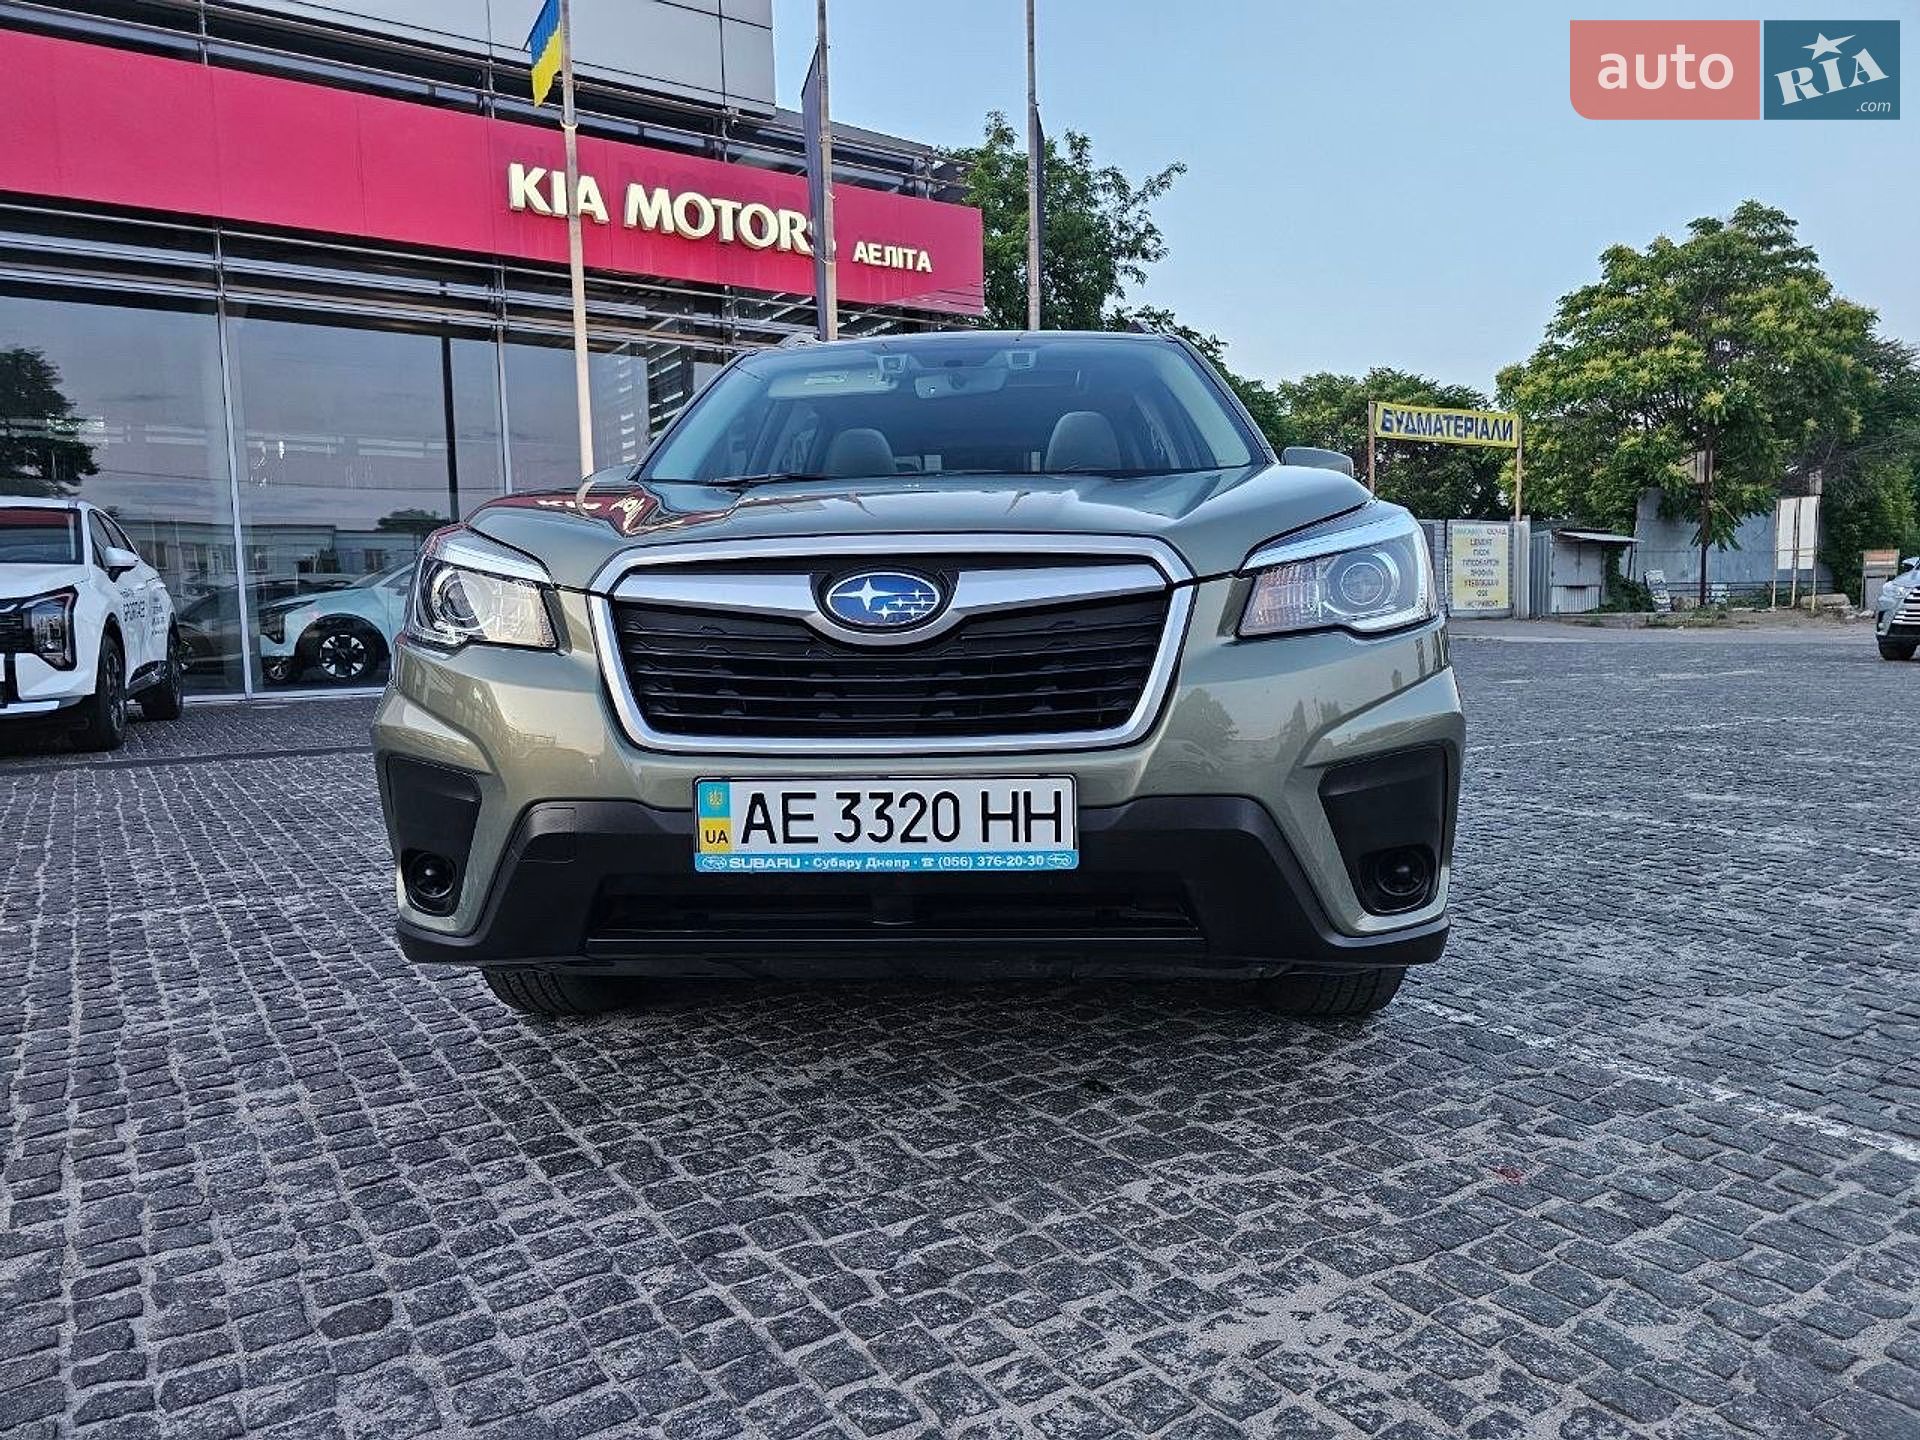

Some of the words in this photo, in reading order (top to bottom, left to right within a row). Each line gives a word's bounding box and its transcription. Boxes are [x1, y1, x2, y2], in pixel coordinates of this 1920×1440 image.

[508, 163, 610, 224] KIA
[623, 181, 837, 257] MOTOR
[852, 241, 933, 273] АЕЛІТА
[1380, 408, 1514, 442] БУДМАТЕРІАЛИ
[741, 791, 819, 845] AE
[833, 791, 961, 843] 3320
[980, 790, 1062, 843] HH
[705, 830, 729, 845] UA
[729, 858, 801, 869] SUBARU
[813, 857, 862, 870] Субару
[865, 857, 910, 870] Днепр
[938, 856, 973, 869] (056)
[977, 855, 1044, 867] 376-20-30
